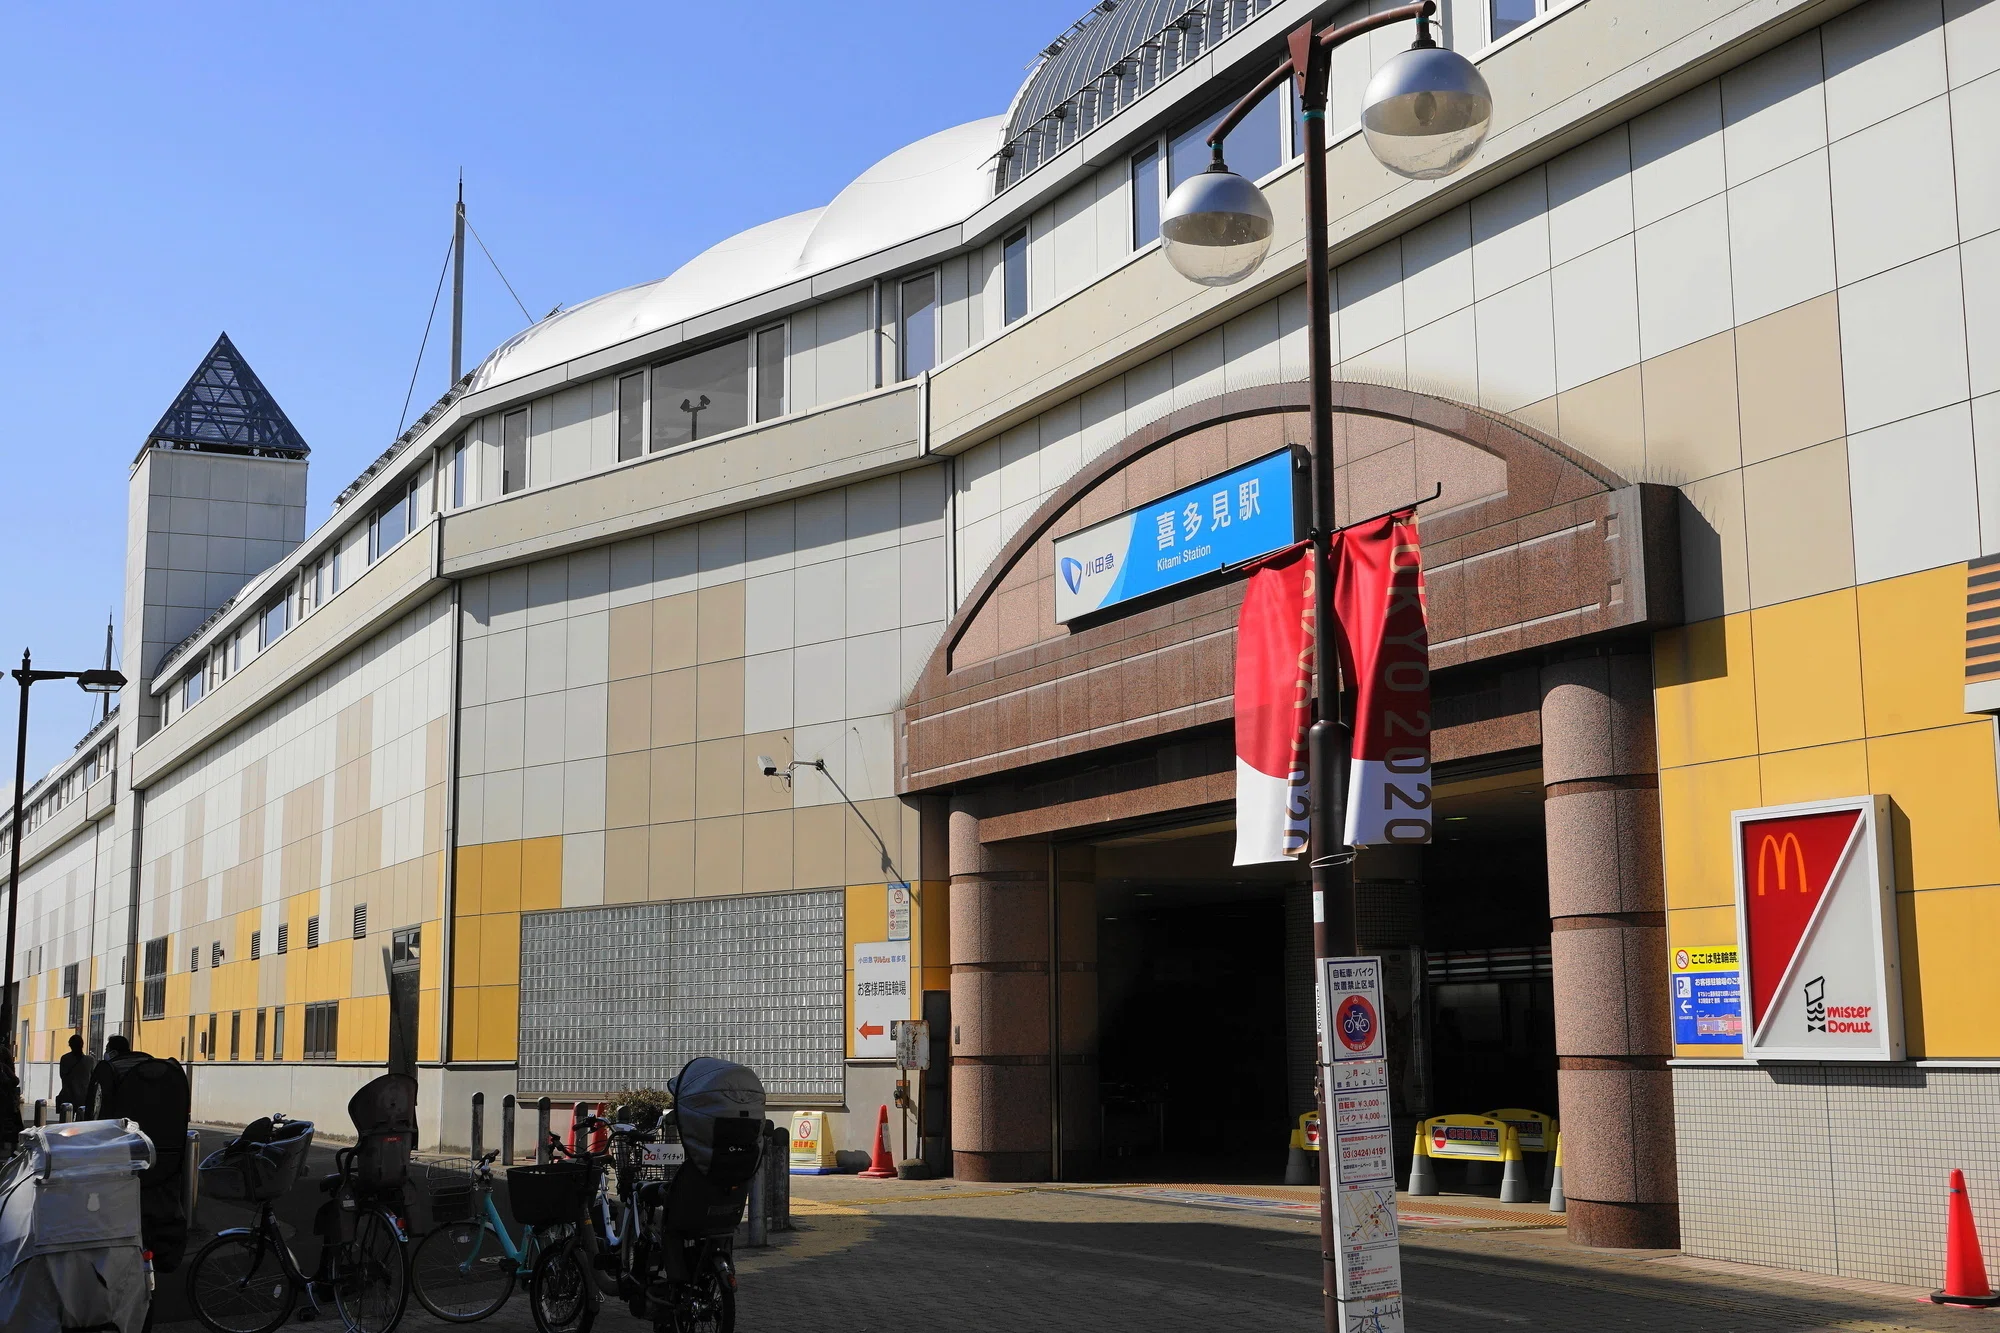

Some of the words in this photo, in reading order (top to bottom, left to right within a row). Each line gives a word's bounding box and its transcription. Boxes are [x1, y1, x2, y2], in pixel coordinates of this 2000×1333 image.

[1156, 478, 1260, 551] 喜多見駅
[1085, 552, 1115, 578] 小田急
[1156, 554, 1181, 572] Kitami
[1183, 544, 1211, 563] Station
[1384, 710, 1432, 844] 2020
[1691, 951, 1739, 965] ここは駐輪禁
[858, 980, 906, 997] お客様用駐輪場
[1334, 980, 1375, 991] 放置禁止区域
[1827, 1006, 1871, 1019] mister
[1828, 1020, 1872, 1033] Donut
[1448, 1128, 1496, 1140] 車両進入禁止
[1343, 1147, 1386, 1158] 03(3424)4191
